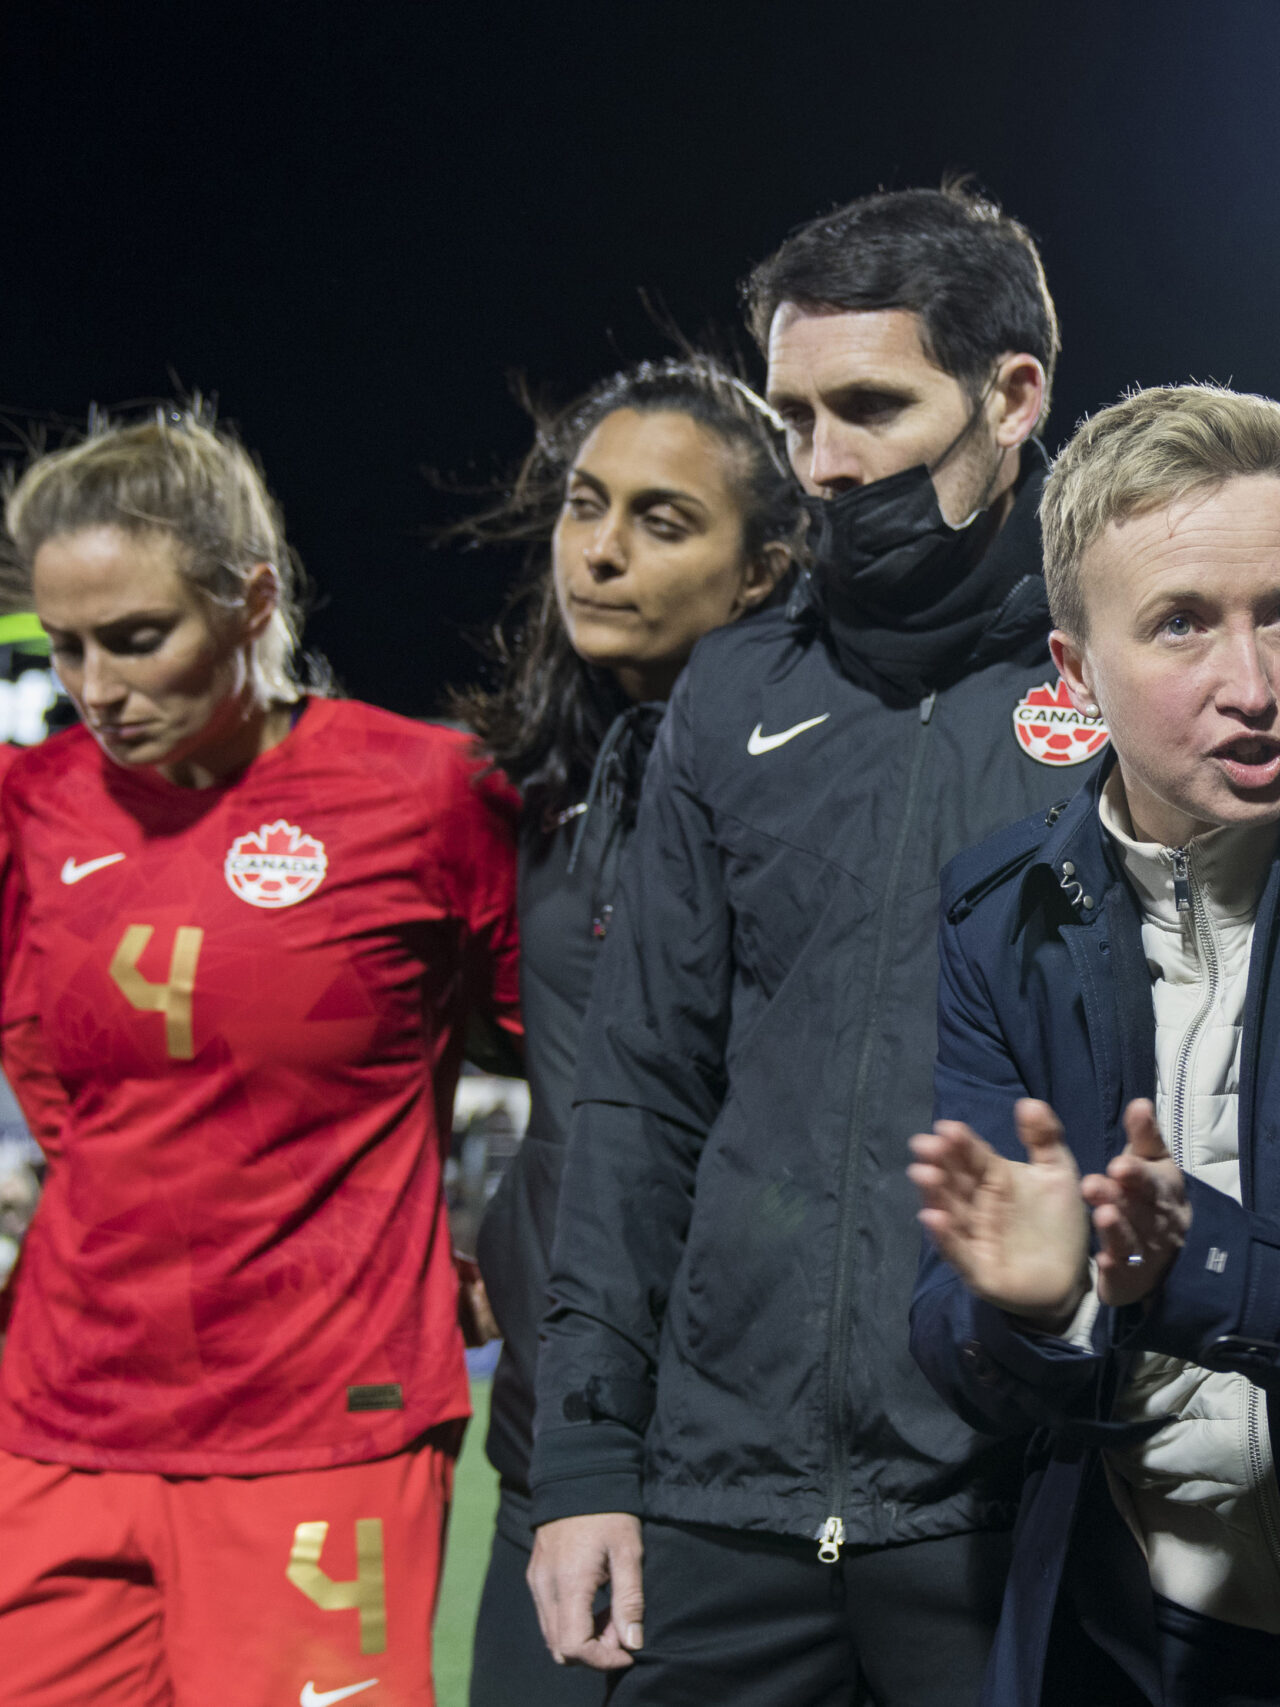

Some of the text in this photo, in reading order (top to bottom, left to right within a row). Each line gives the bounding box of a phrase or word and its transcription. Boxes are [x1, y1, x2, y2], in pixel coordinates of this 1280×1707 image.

[1018, 708, 1105, 727] CANAD
[231, 857, 320, 874] CANADA
[108, 924, 204, 1060] 4
[285, 1517, 388, 1656] 4
